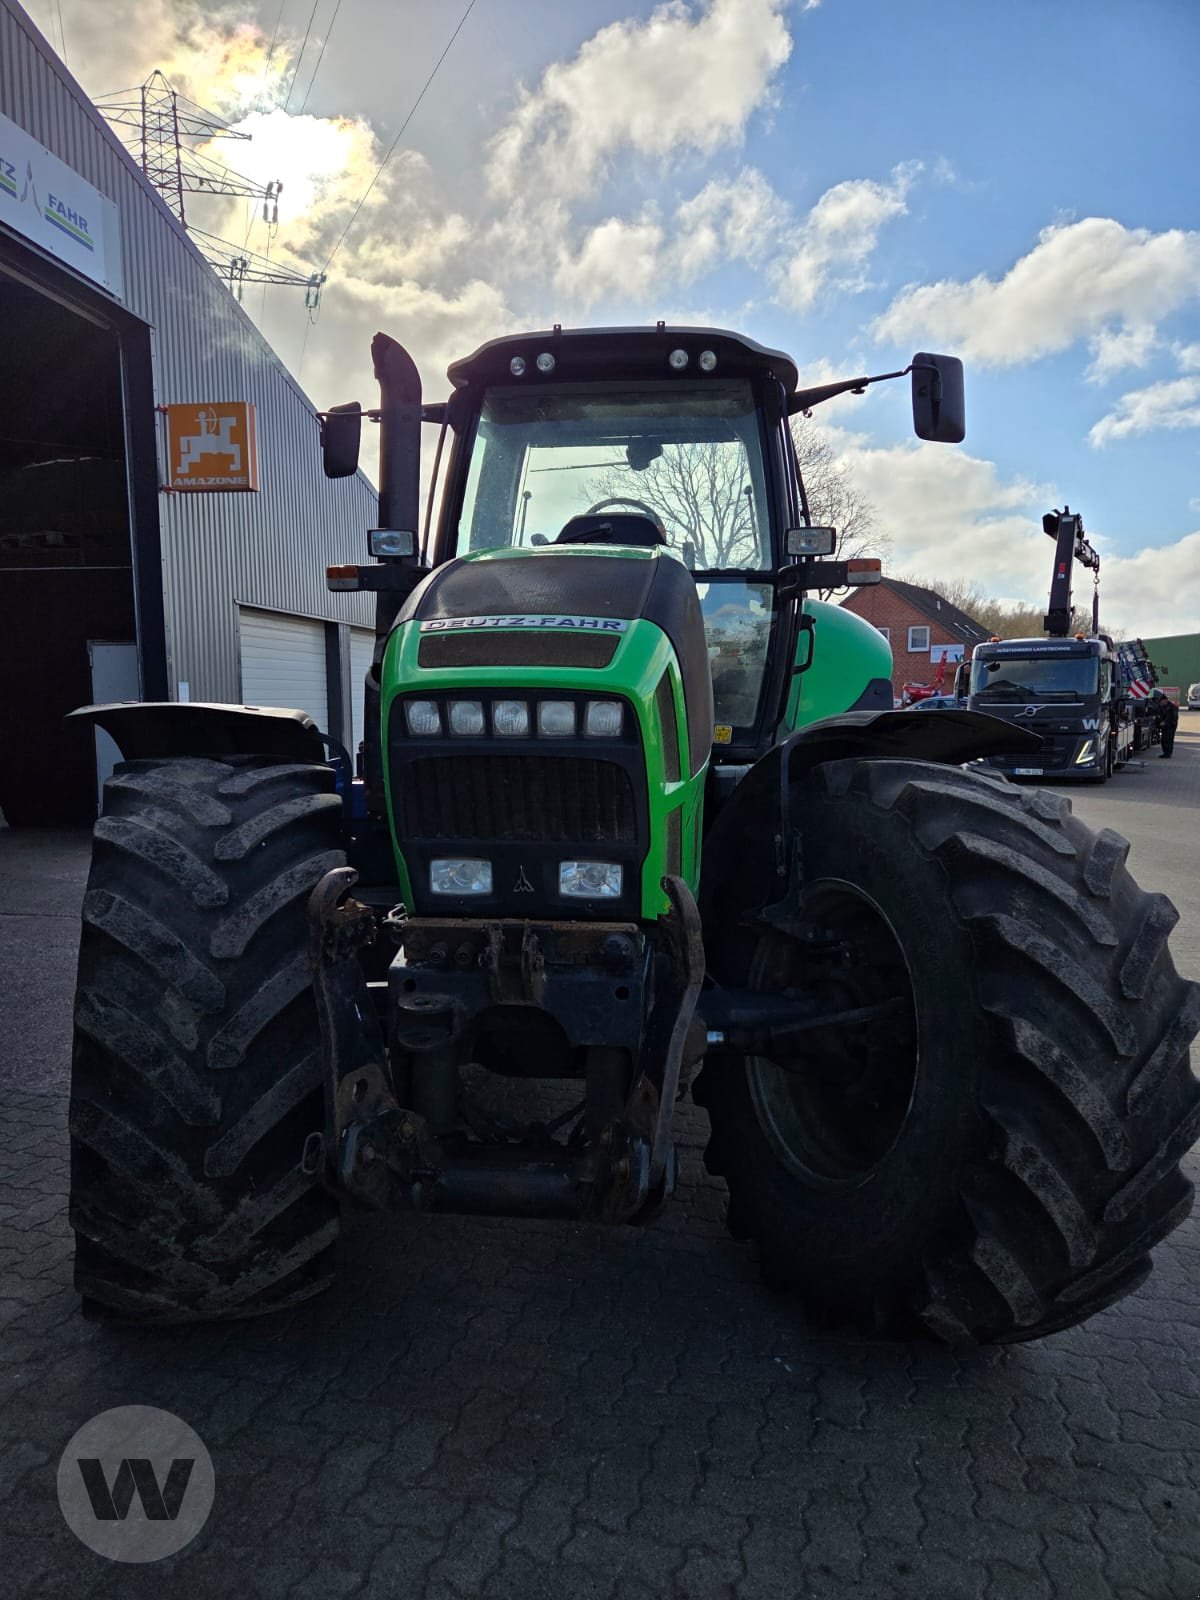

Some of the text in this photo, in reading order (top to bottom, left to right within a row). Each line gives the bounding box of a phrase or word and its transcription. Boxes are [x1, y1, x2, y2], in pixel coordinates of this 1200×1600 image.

[48, 192, 89, 234] FAHR
[174, 477, 248, 486] AMAZONE
[425, 617, 622, 630] DEUTZ-FAHR
